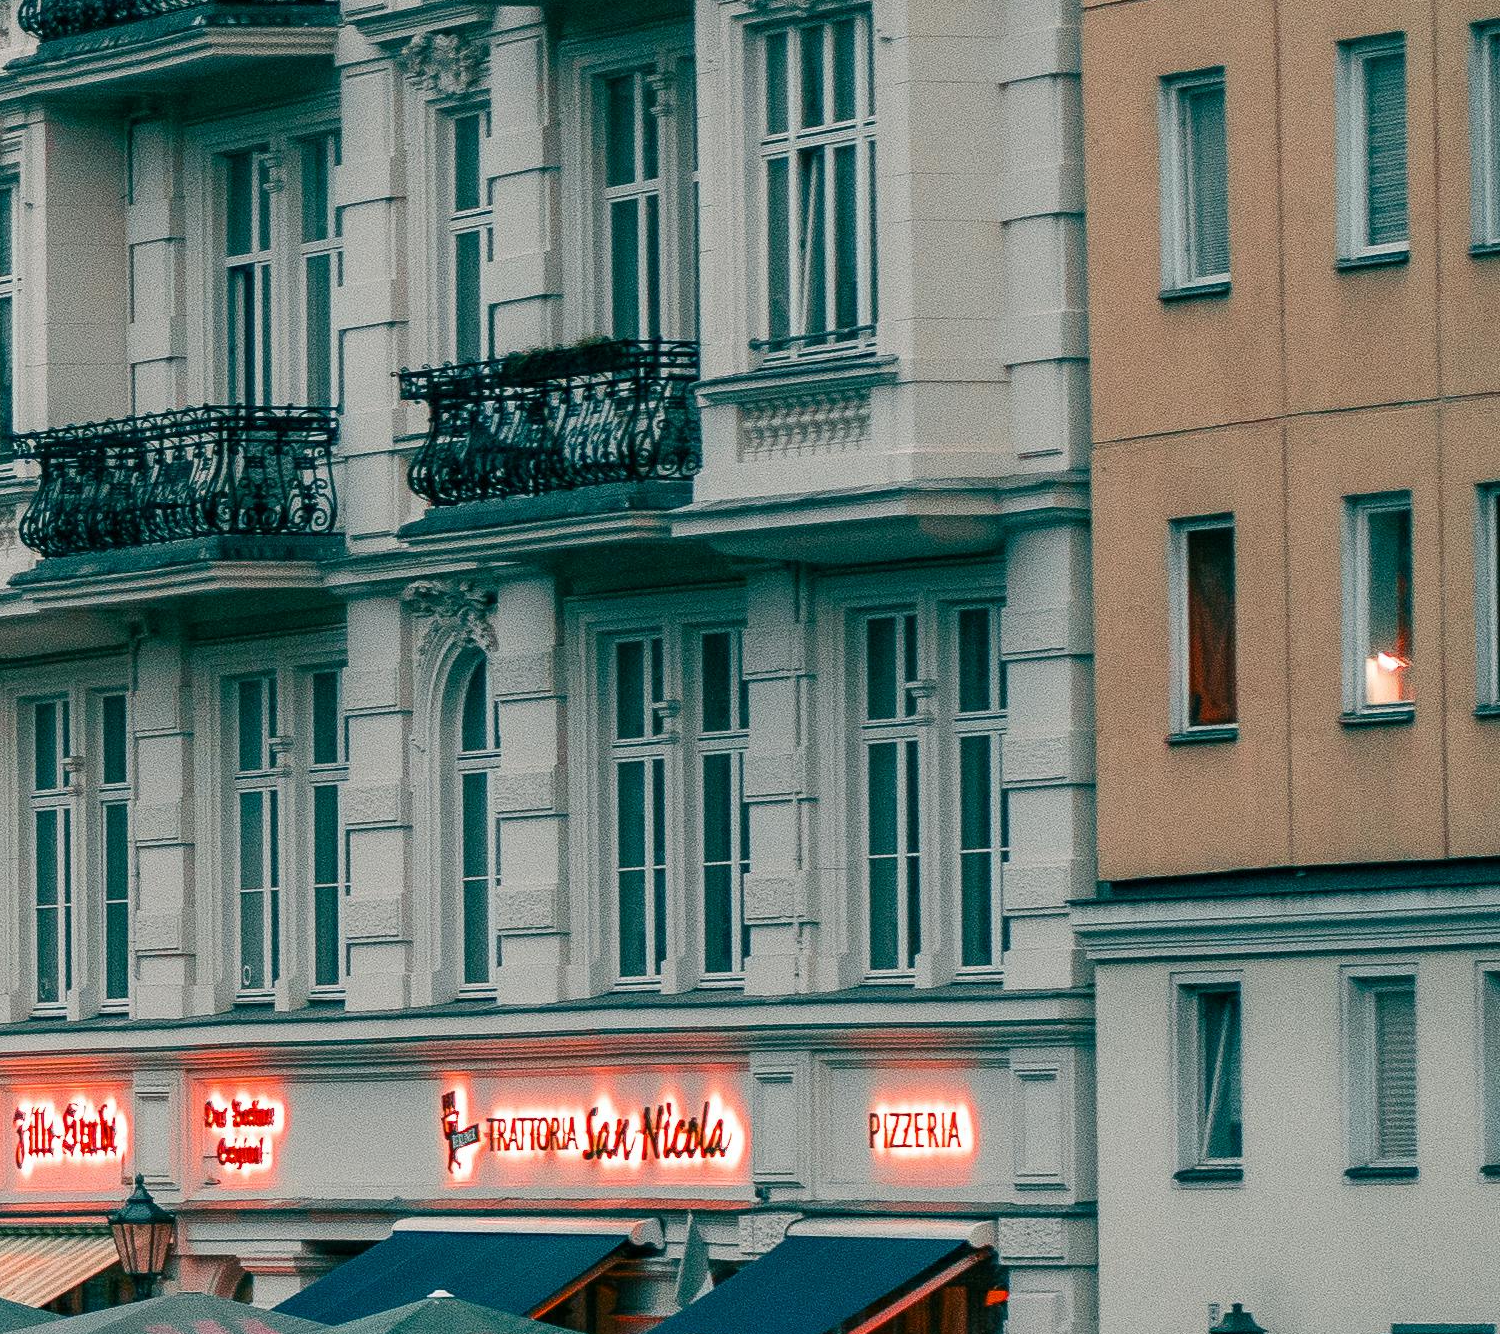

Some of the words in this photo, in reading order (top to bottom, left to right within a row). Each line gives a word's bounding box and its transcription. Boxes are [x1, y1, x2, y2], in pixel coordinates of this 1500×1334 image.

[487, 1116, 579, 1152] TRATTORIA
[583, 1107, 638, 1160] San
[636, 1101, 732, 1160] Nicola
[869, 1111, 962, 1149] PIZZERIA
